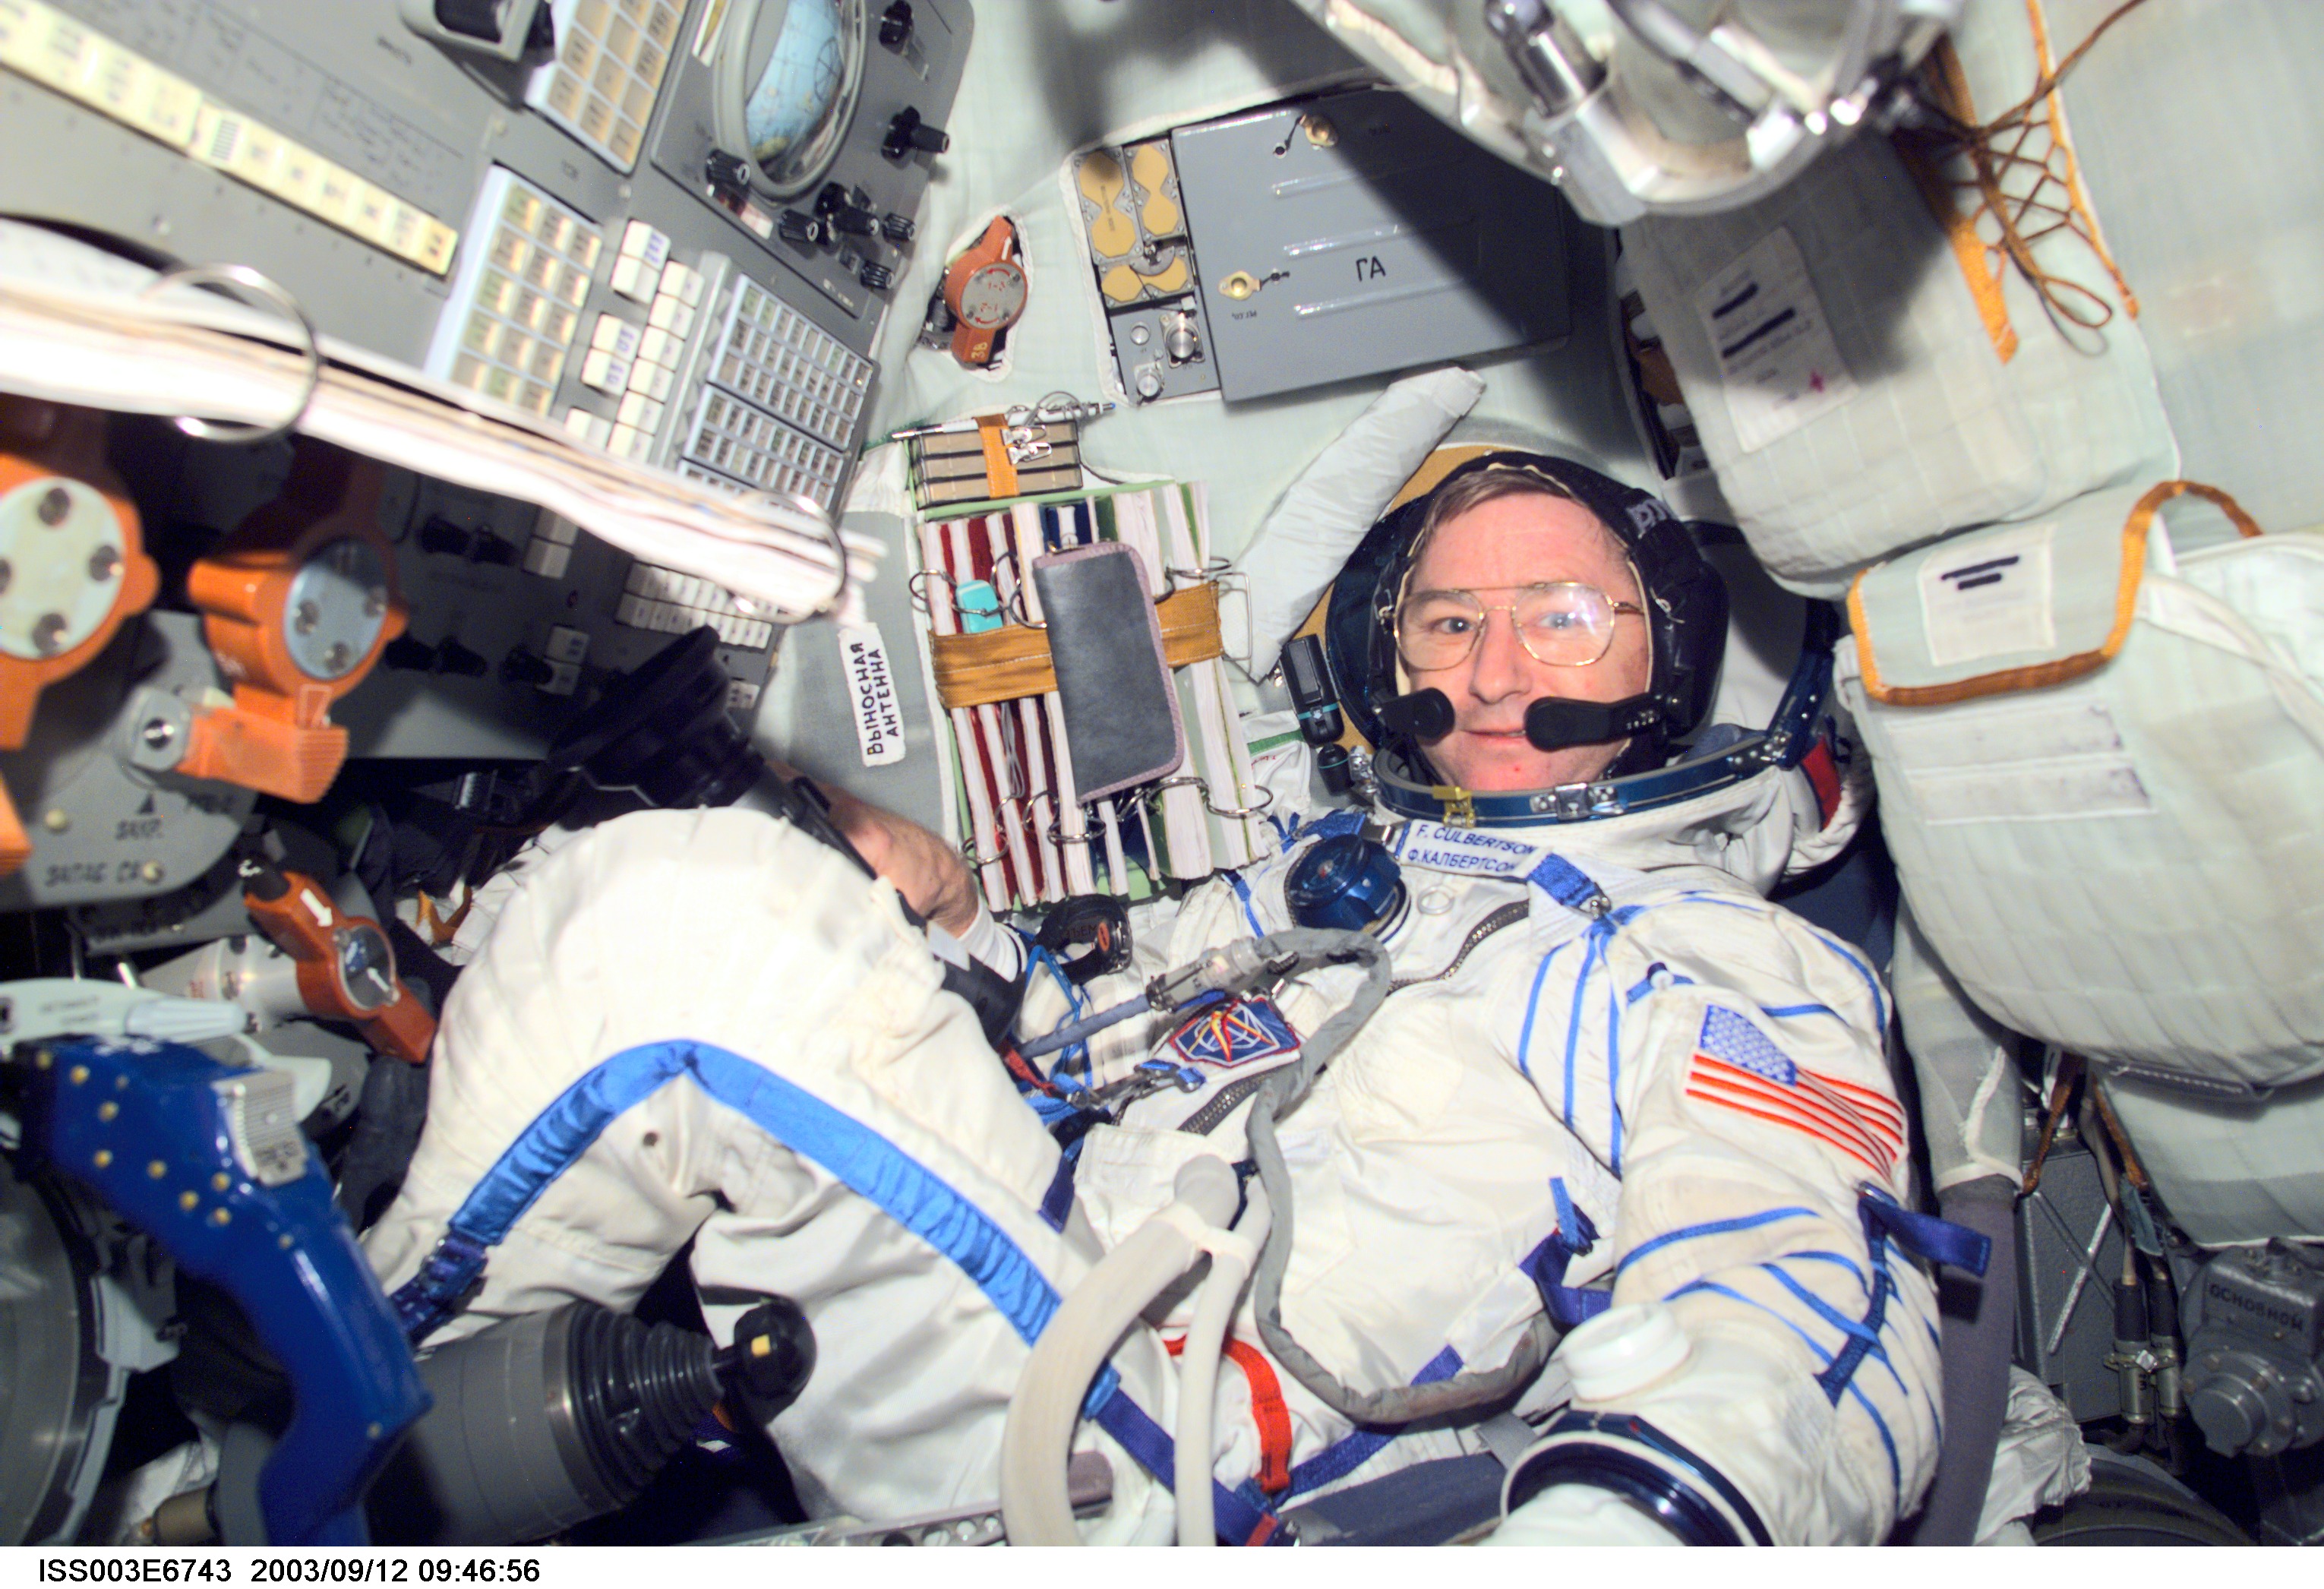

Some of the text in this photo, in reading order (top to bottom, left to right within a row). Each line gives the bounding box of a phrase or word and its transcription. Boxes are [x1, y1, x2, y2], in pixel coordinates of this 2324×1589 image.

[1356, 255, 1386, 282] ГА
[849, 643, 884, 755] ВЫНОСНАЯ
[867, 649, 899, 737] АНТЕННА
[1416, 824, 1538, 855] F. CULBERTSON
